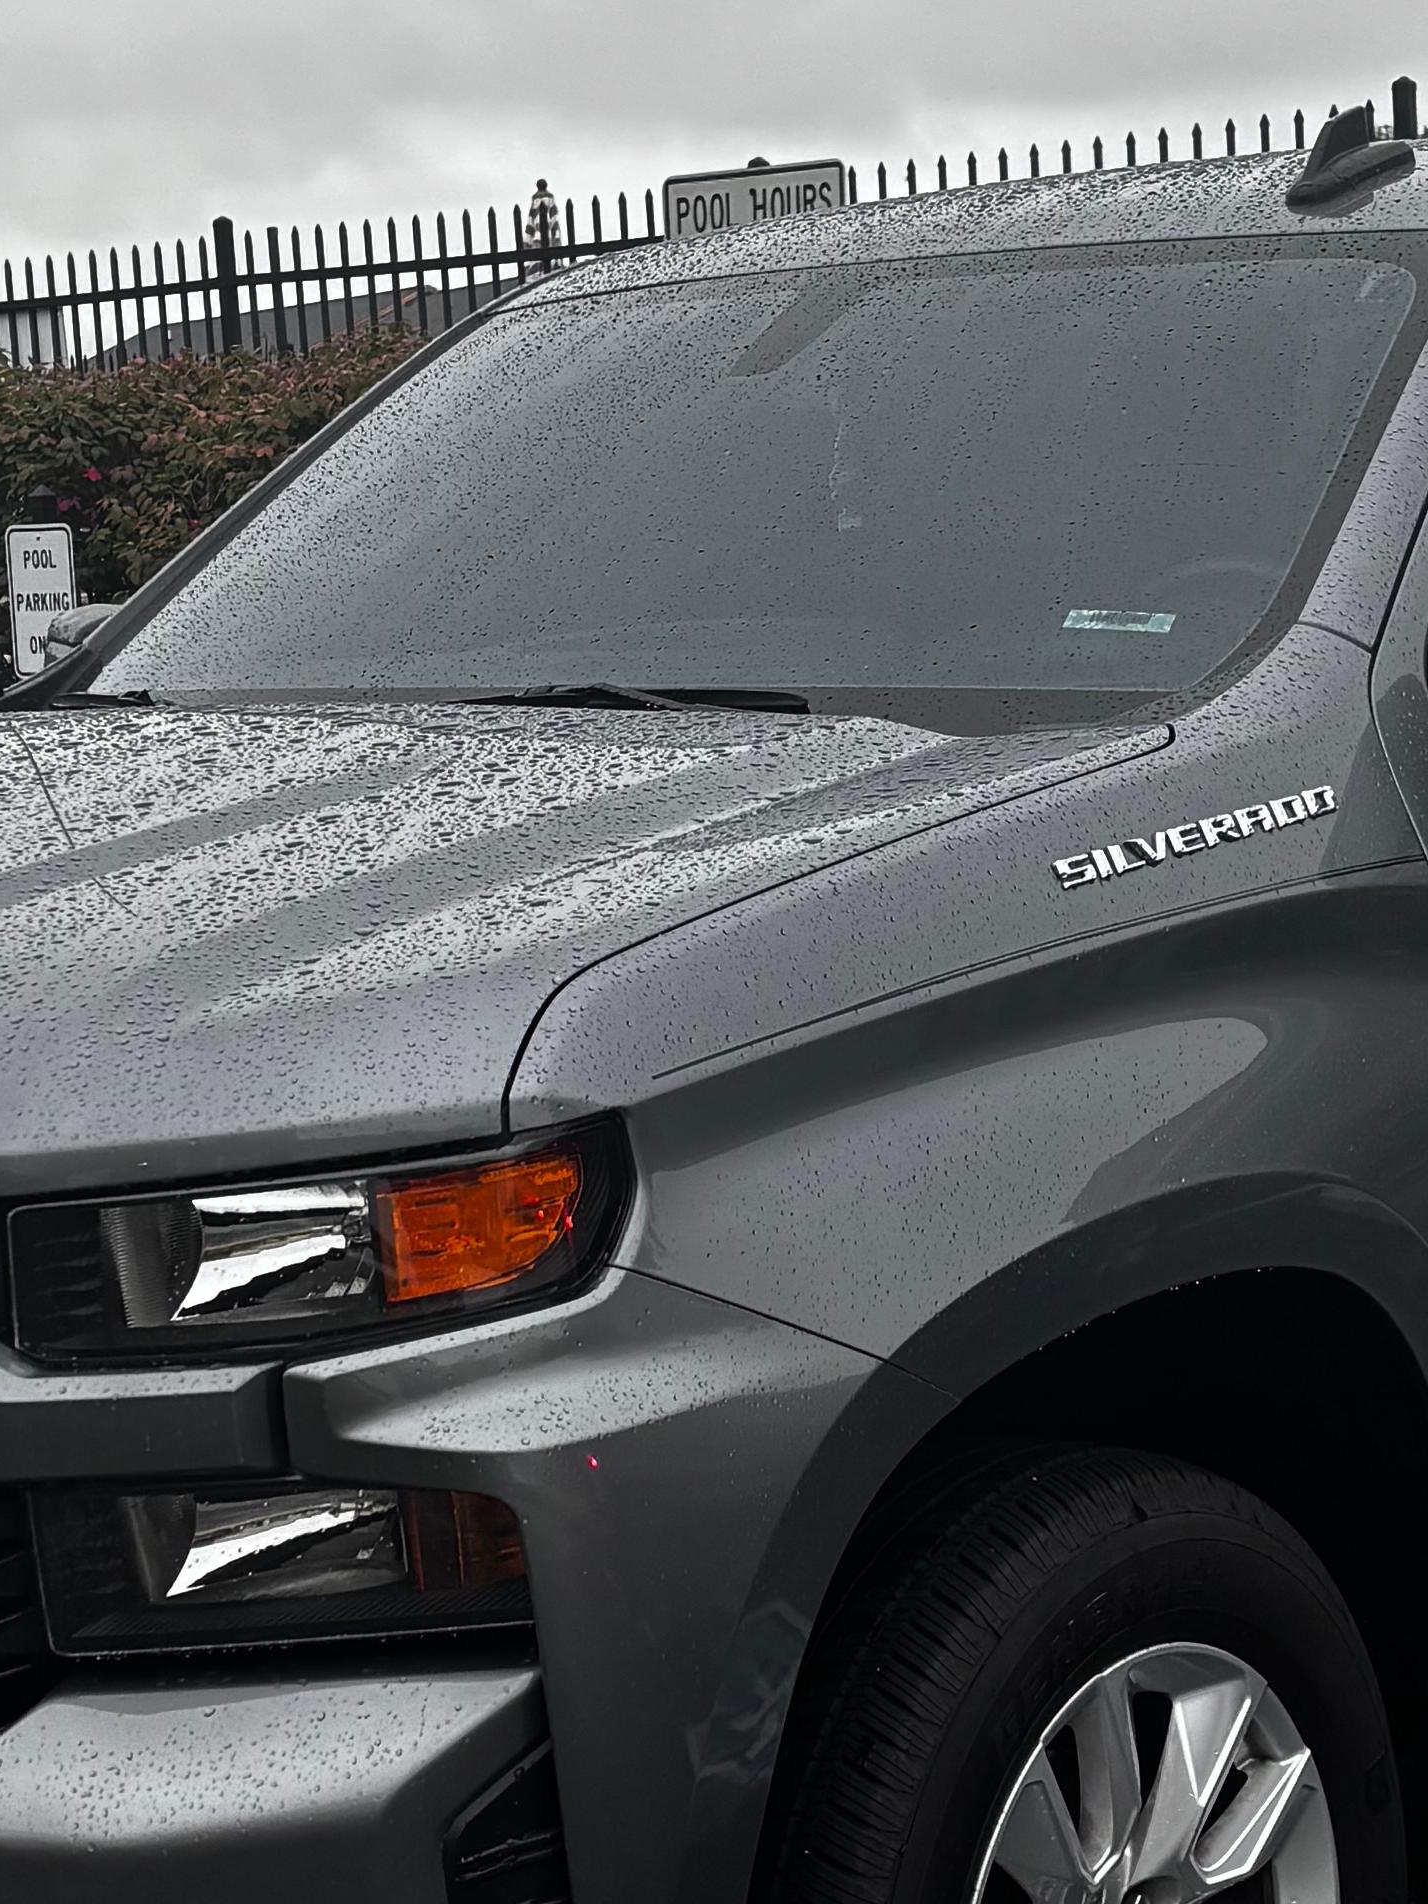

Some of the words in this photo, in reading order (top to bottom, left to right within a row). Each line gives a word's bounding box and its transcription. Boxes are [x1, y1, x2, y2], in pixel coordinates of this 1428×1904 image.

[676, 192, 739, 236] POOL
[751, 181, 833, 221] HOURS
[23, 549, 58, 570] POOL
[16, 592, 70, 613] PARKING
[29, 635, 46, 656] ON
[1053, 785, 1338, 891] SILVERADO
